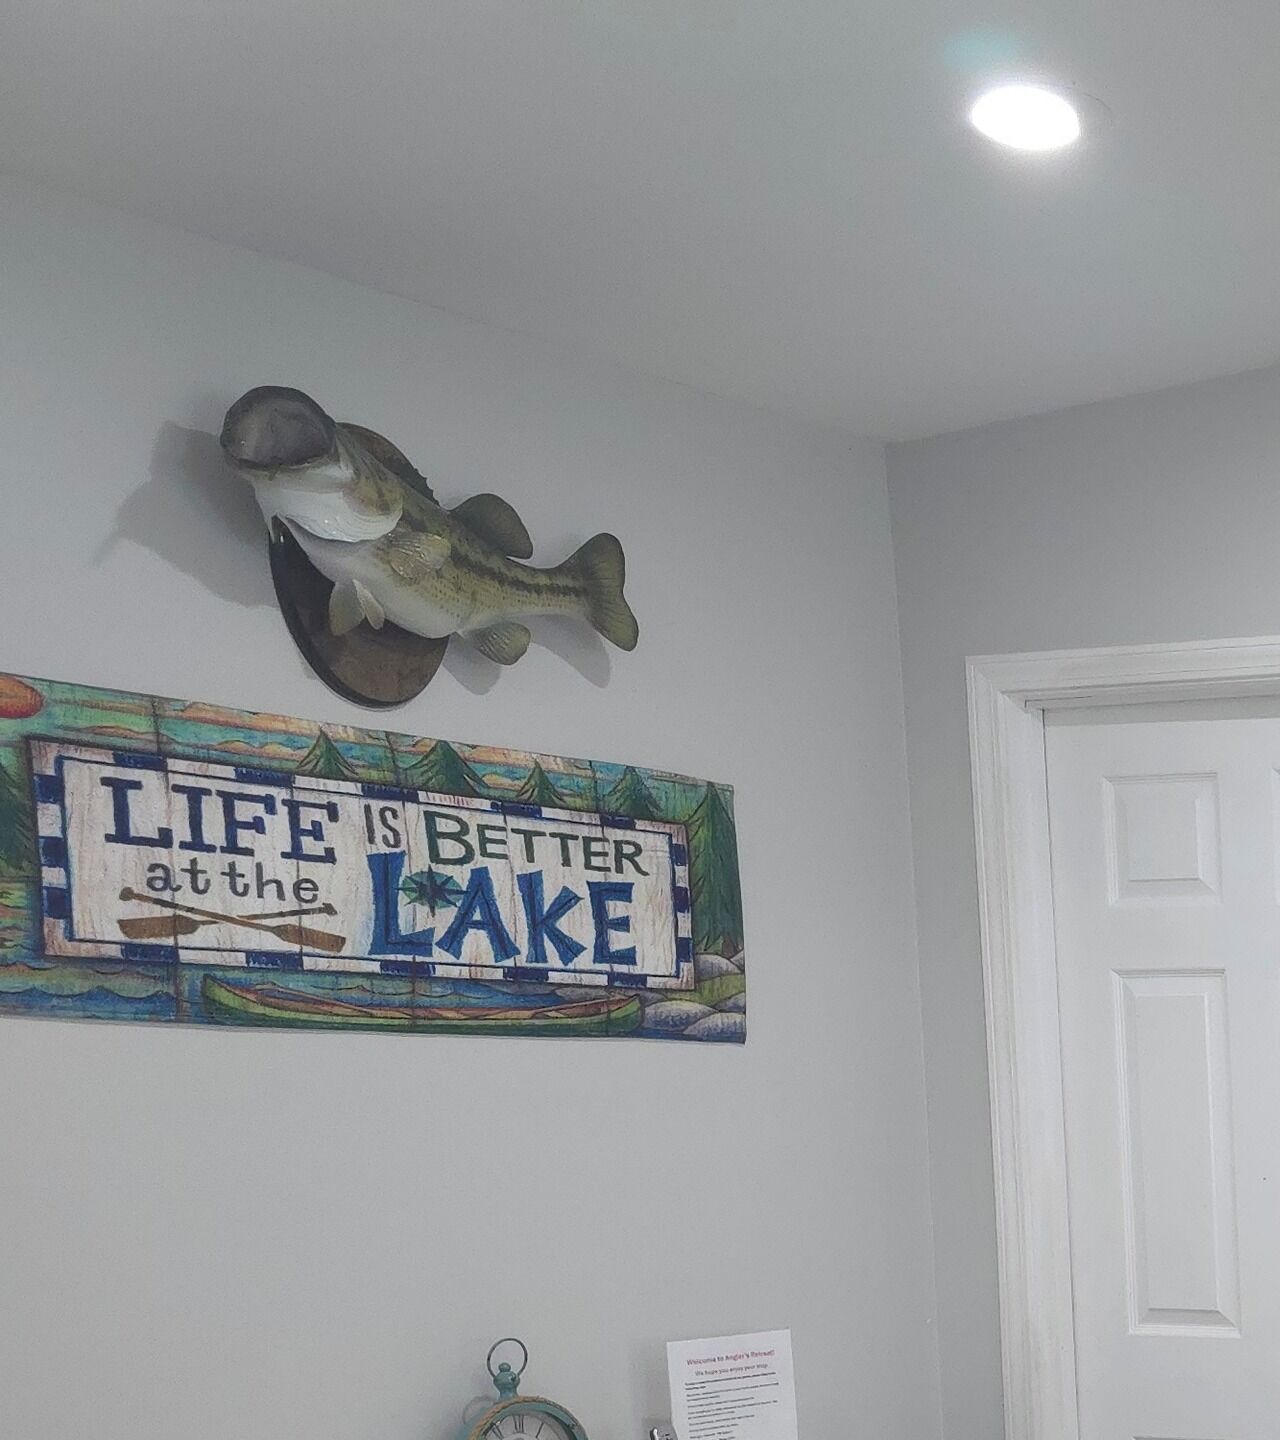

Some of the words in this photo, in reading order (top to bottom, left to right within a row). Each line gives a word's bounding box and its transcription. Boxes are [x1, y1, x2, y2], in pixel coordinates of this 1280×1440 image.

[100, 776, 339, 865] LIFE
[363, 802, 401, 849] IS
[423, 809, 649, 876] BETTER
[146, 857, 212, 896] at
[220, 861, 319, 904] the
[366, 850, 637, 966] LAKE
